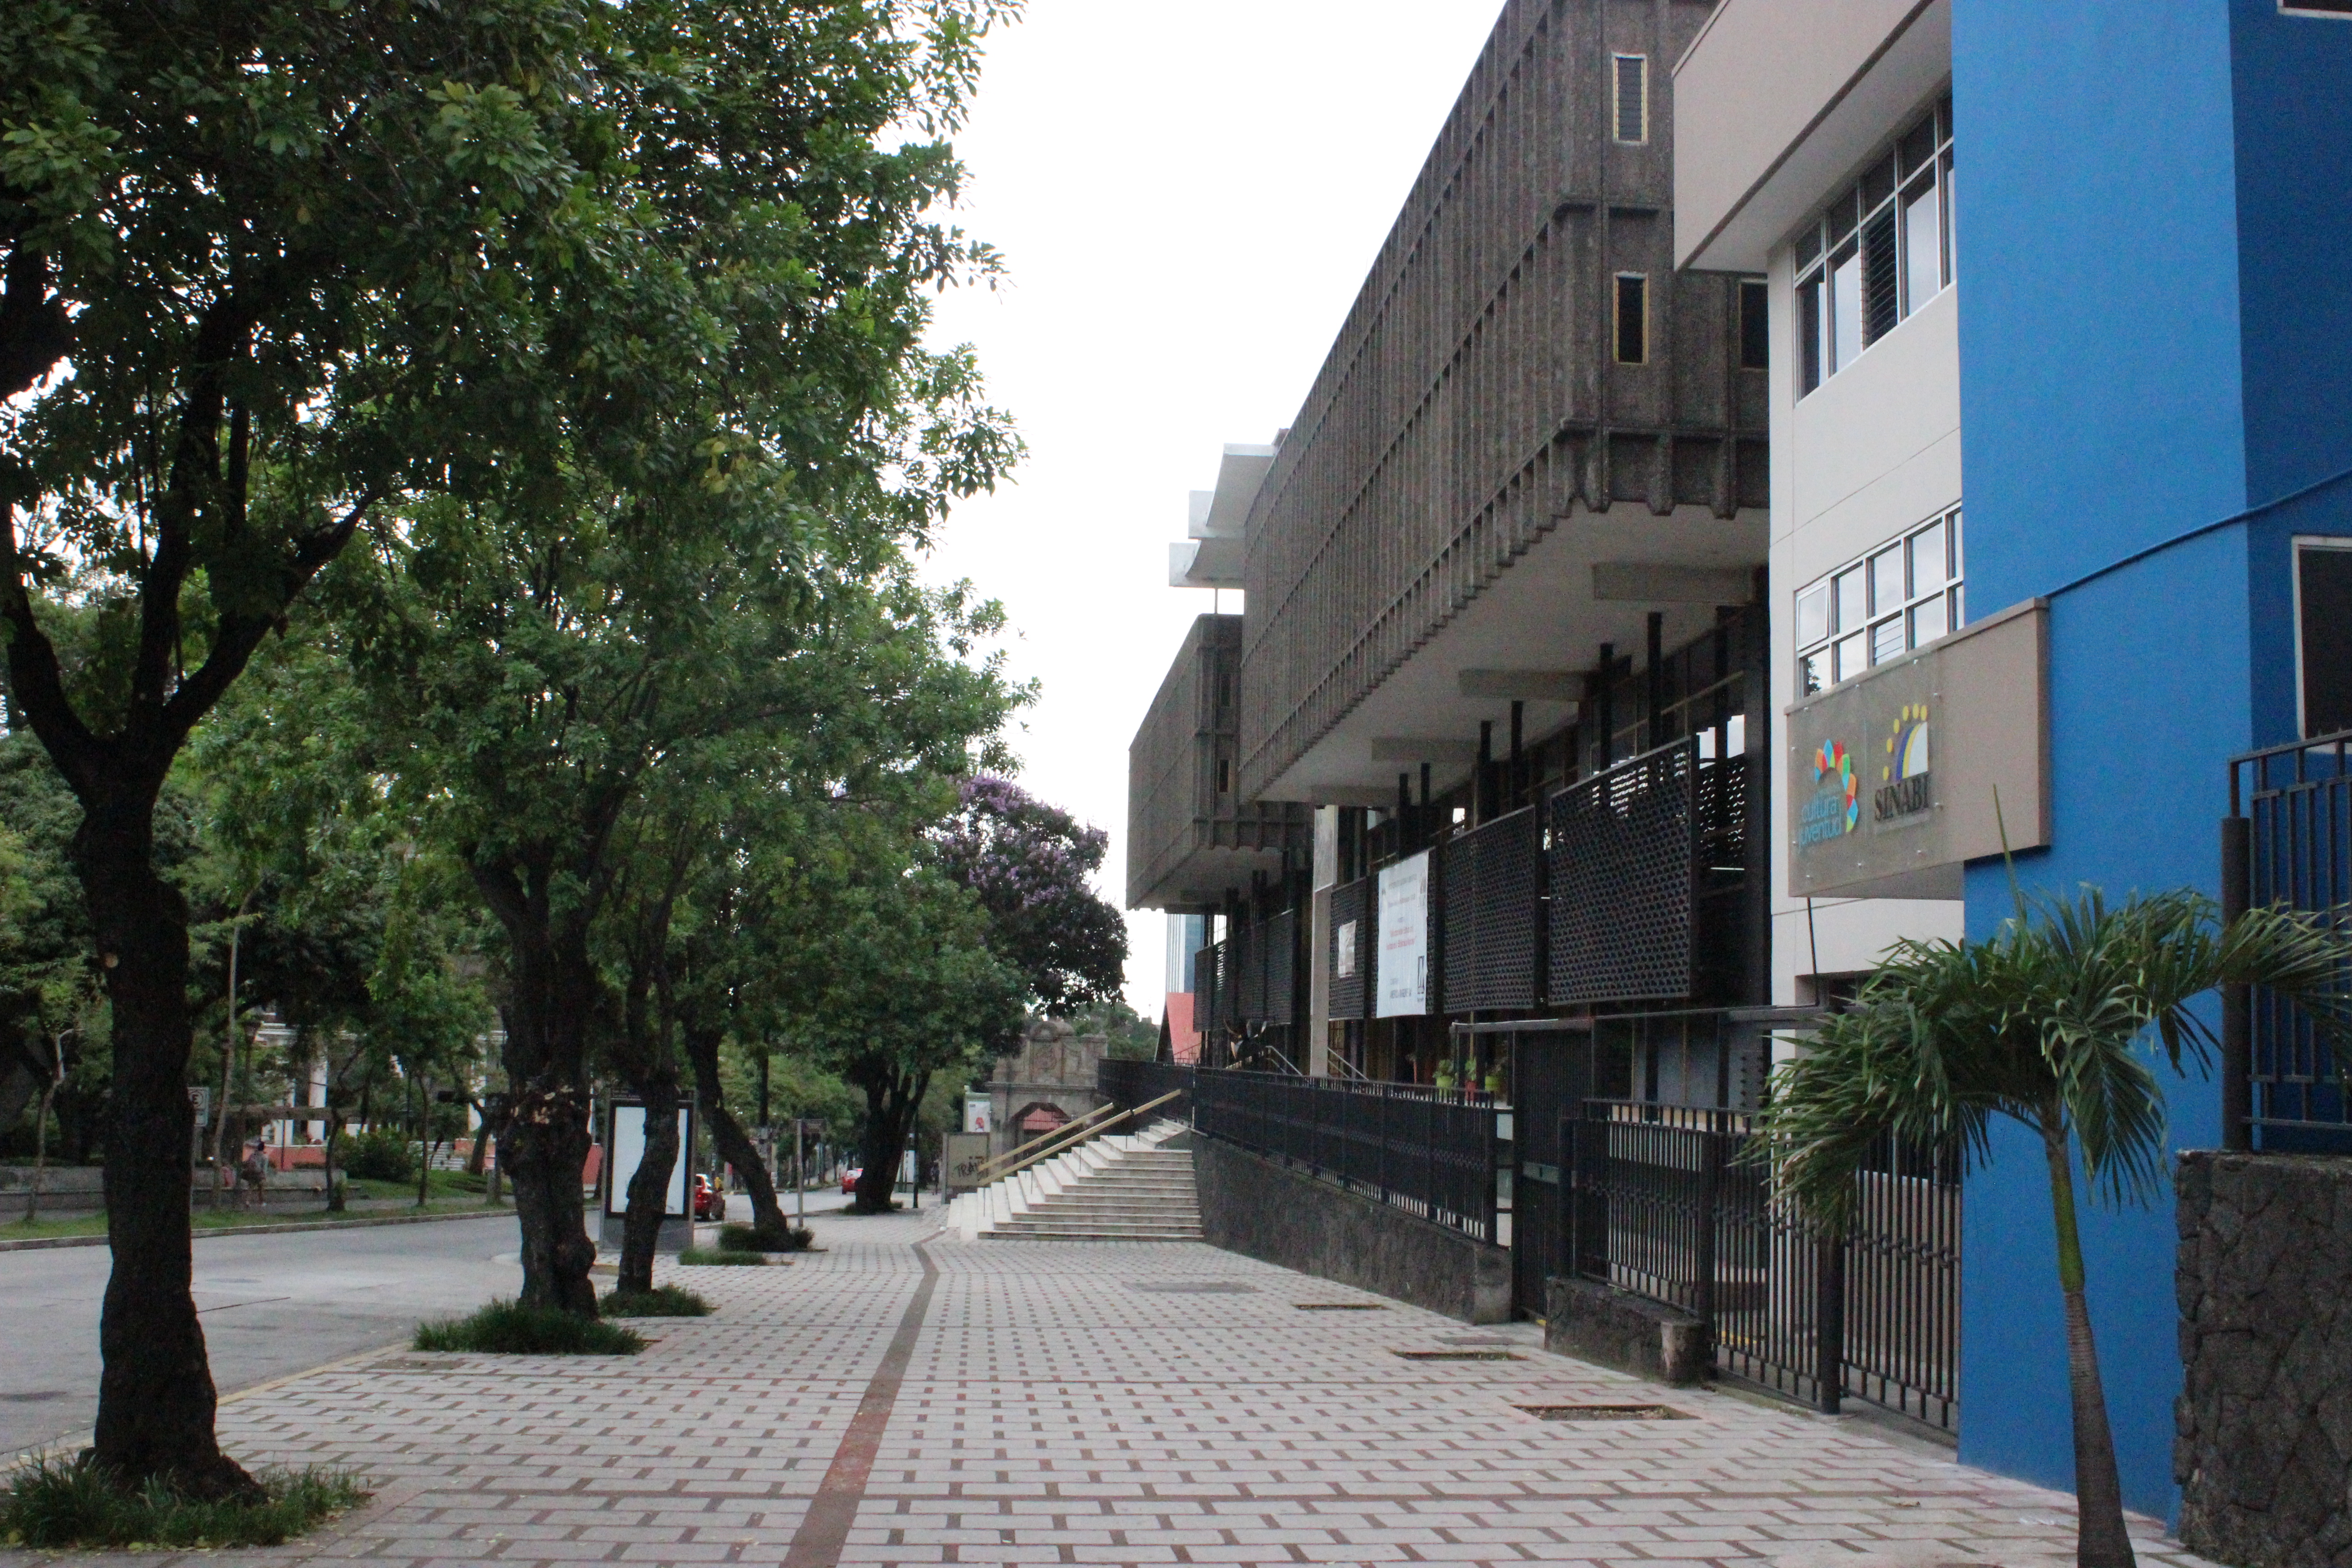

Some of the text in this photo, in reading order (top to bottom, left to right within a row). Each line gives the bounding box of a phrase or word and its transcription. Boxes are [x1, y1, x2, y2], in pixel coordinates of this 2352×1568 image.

[1802, 793, 1838, 823] cultura
[1875, 774, 1929, 821] SINABI
[1798, 805, 1841, 854] juventud
